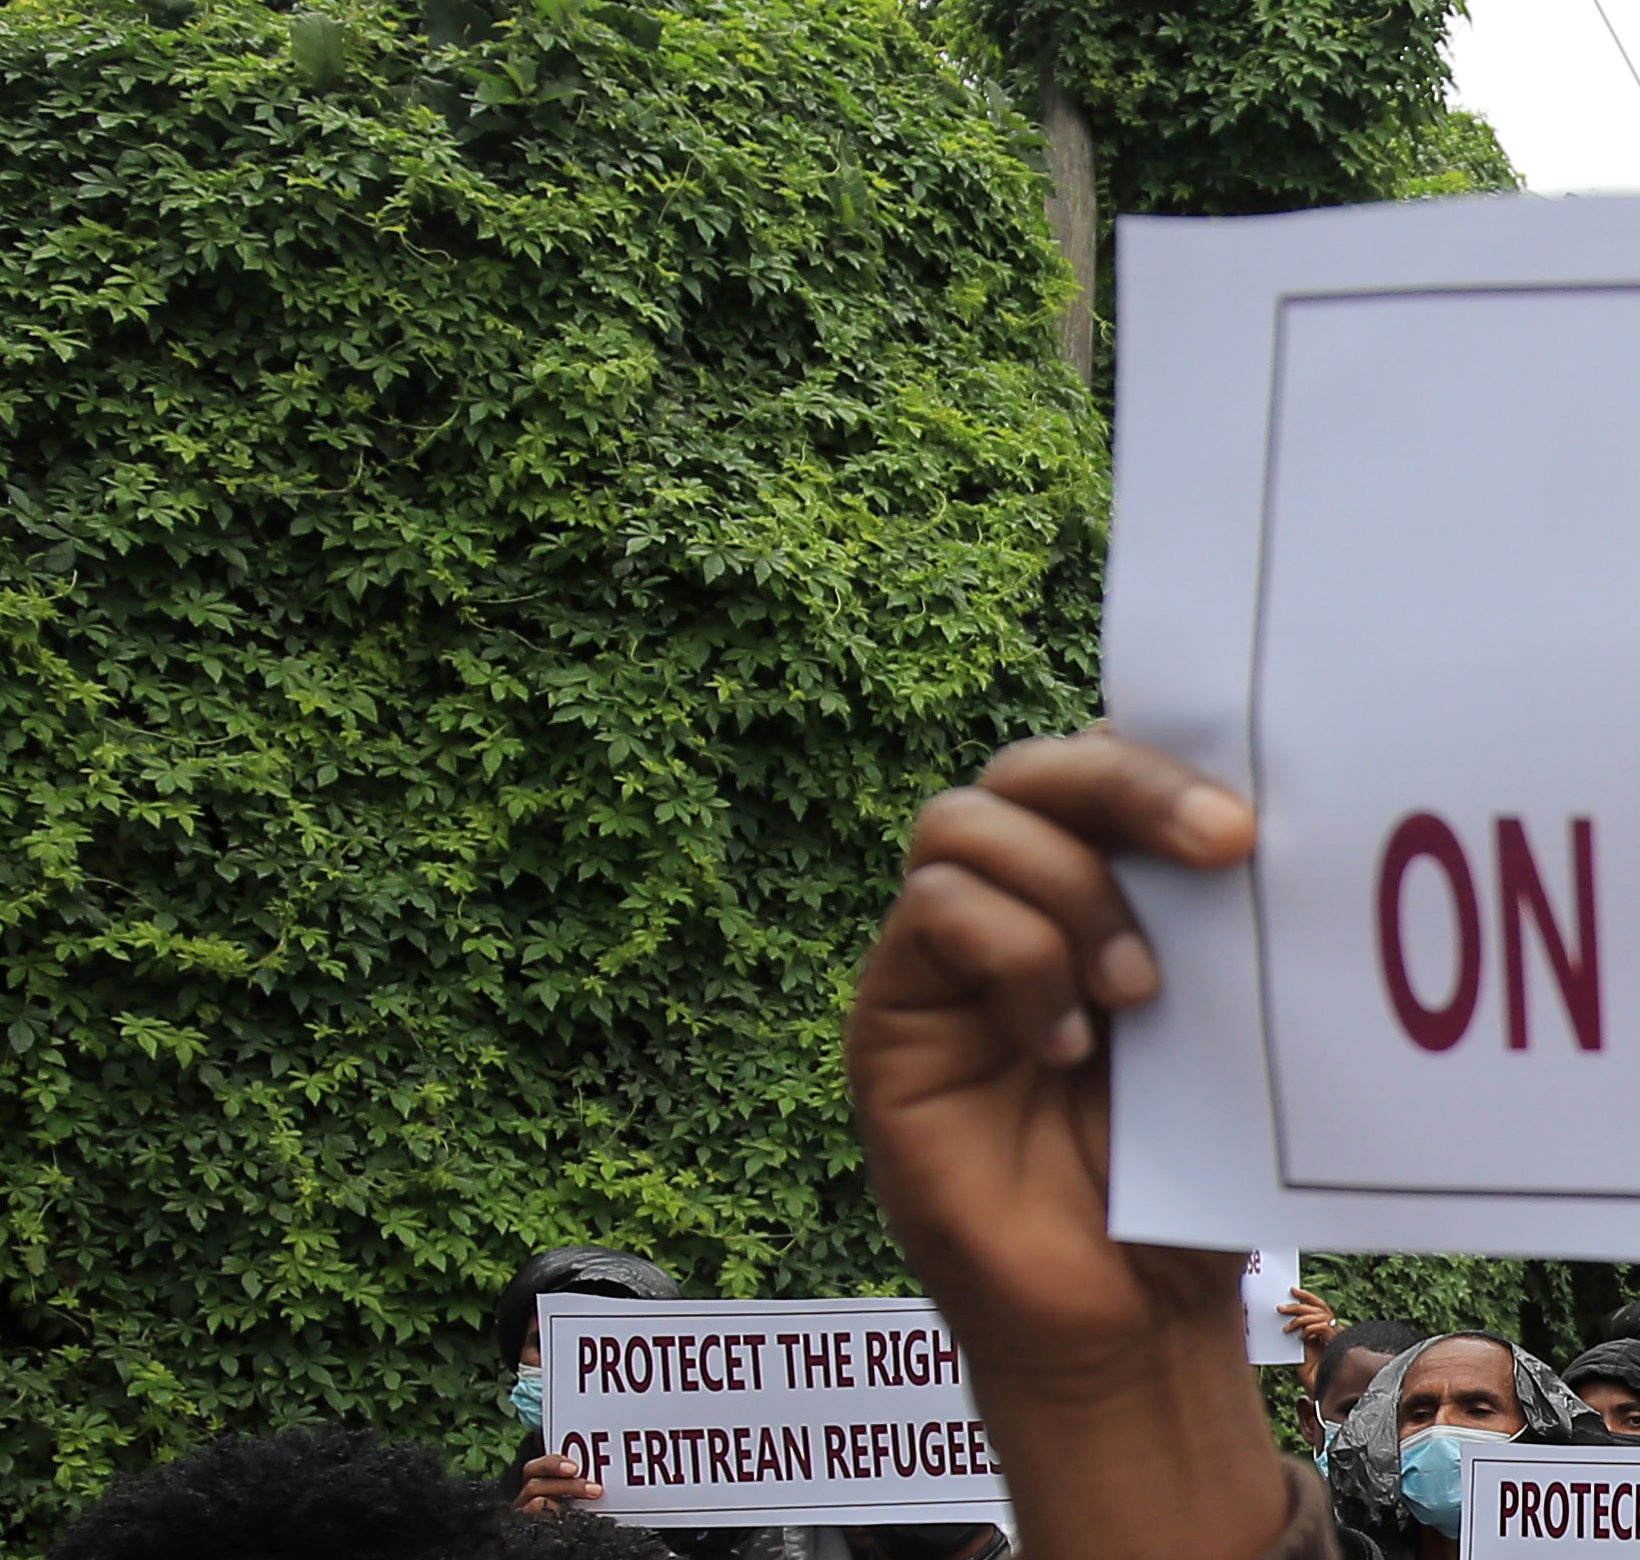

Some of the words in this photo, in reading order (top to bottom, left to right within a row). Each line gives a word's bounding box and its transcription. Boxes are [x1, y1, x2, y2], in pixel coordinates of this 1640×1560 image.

[1375, 811, 1600, 1054] ON
[578, 1334, 765, 1394] PROTECET
[778, 1332, 855, 1390] THE
[867, 1330, 960, 1386] RIGH
[562, 1431, 611, 1484] OF
[623, 1425, 812, 1486] ERITREAN
[825, 1420, 1002, 1480] REFUGEE
